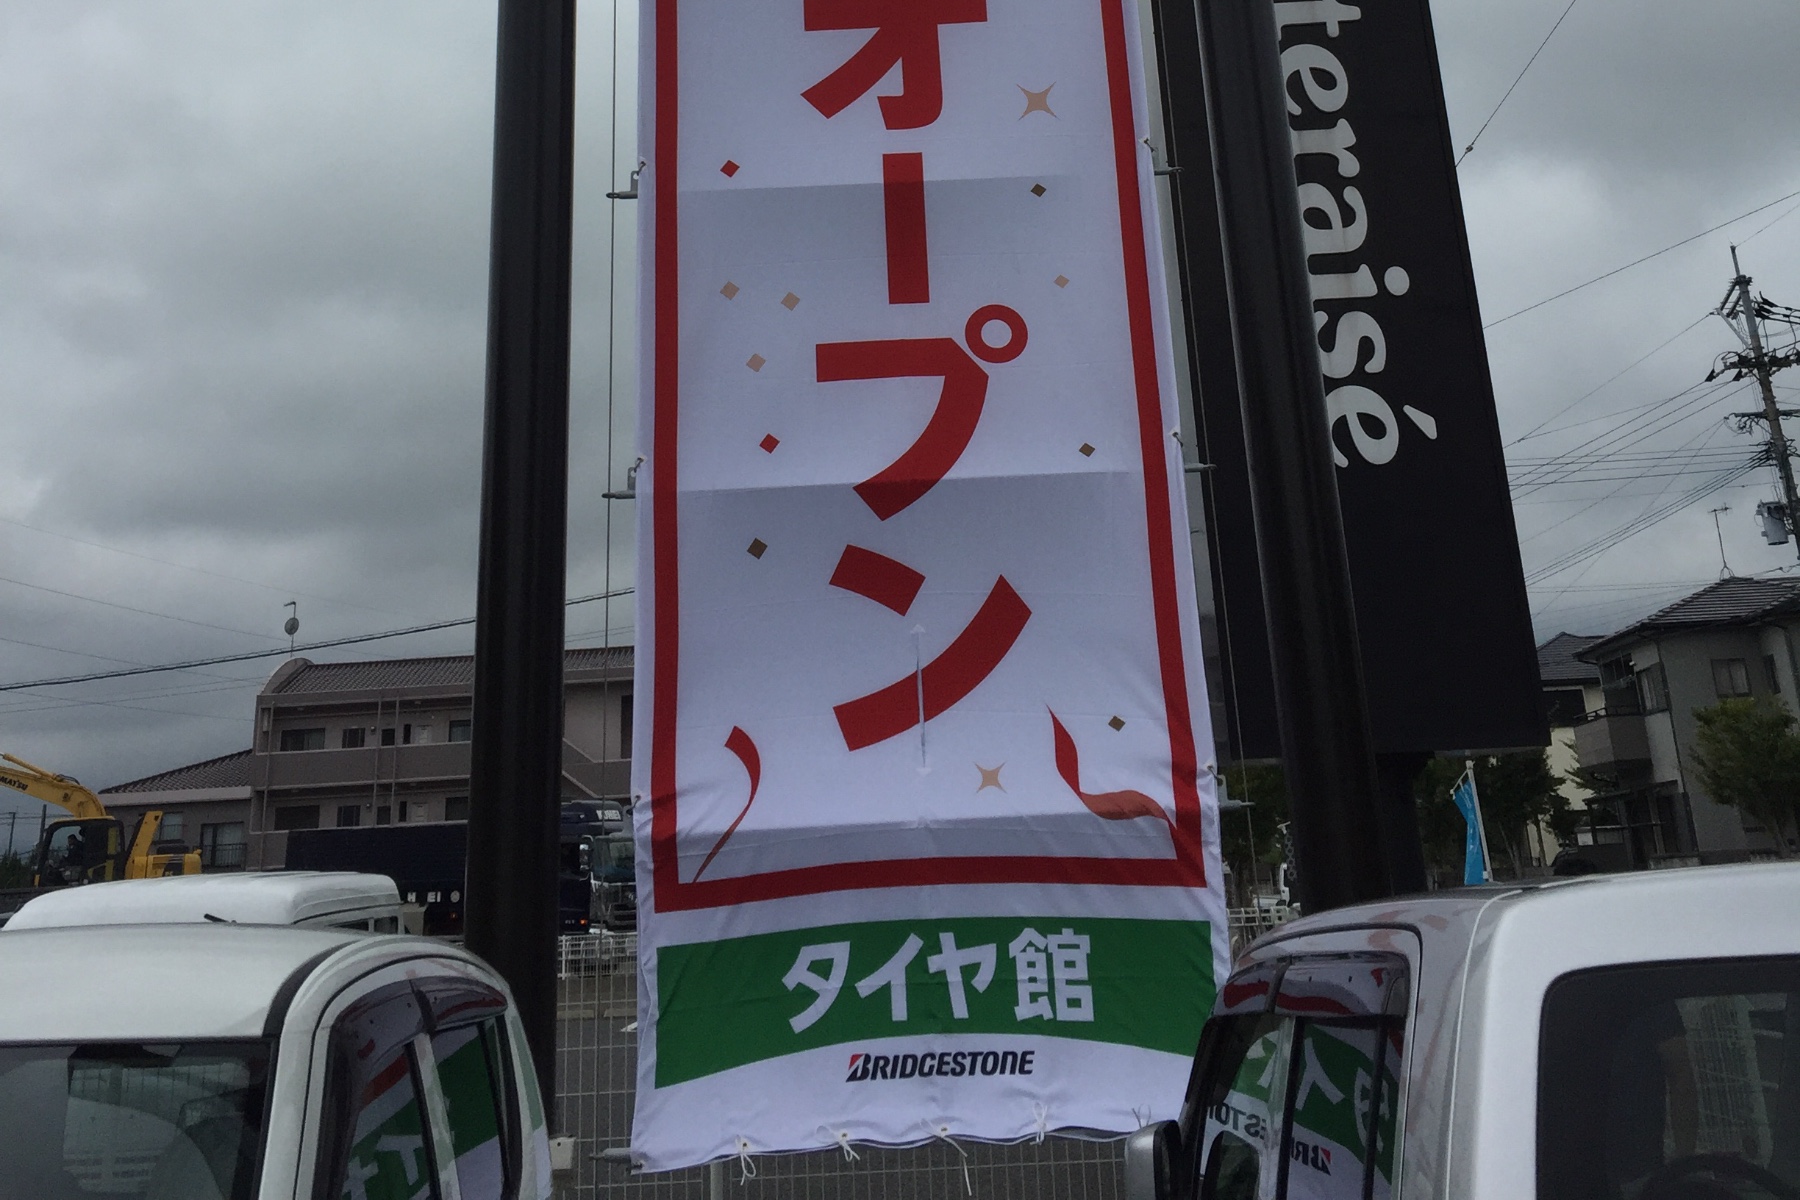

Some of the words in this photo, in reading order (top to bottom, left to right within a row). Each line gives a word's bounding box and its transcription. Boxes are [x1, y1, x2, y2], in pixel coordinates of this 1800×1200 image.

[0, 776, 28, 791] MATSU
[781, 927, 1095, 1034] タイヤ館
[846, 1050, 1035, 1084] BRIDGESTONE
